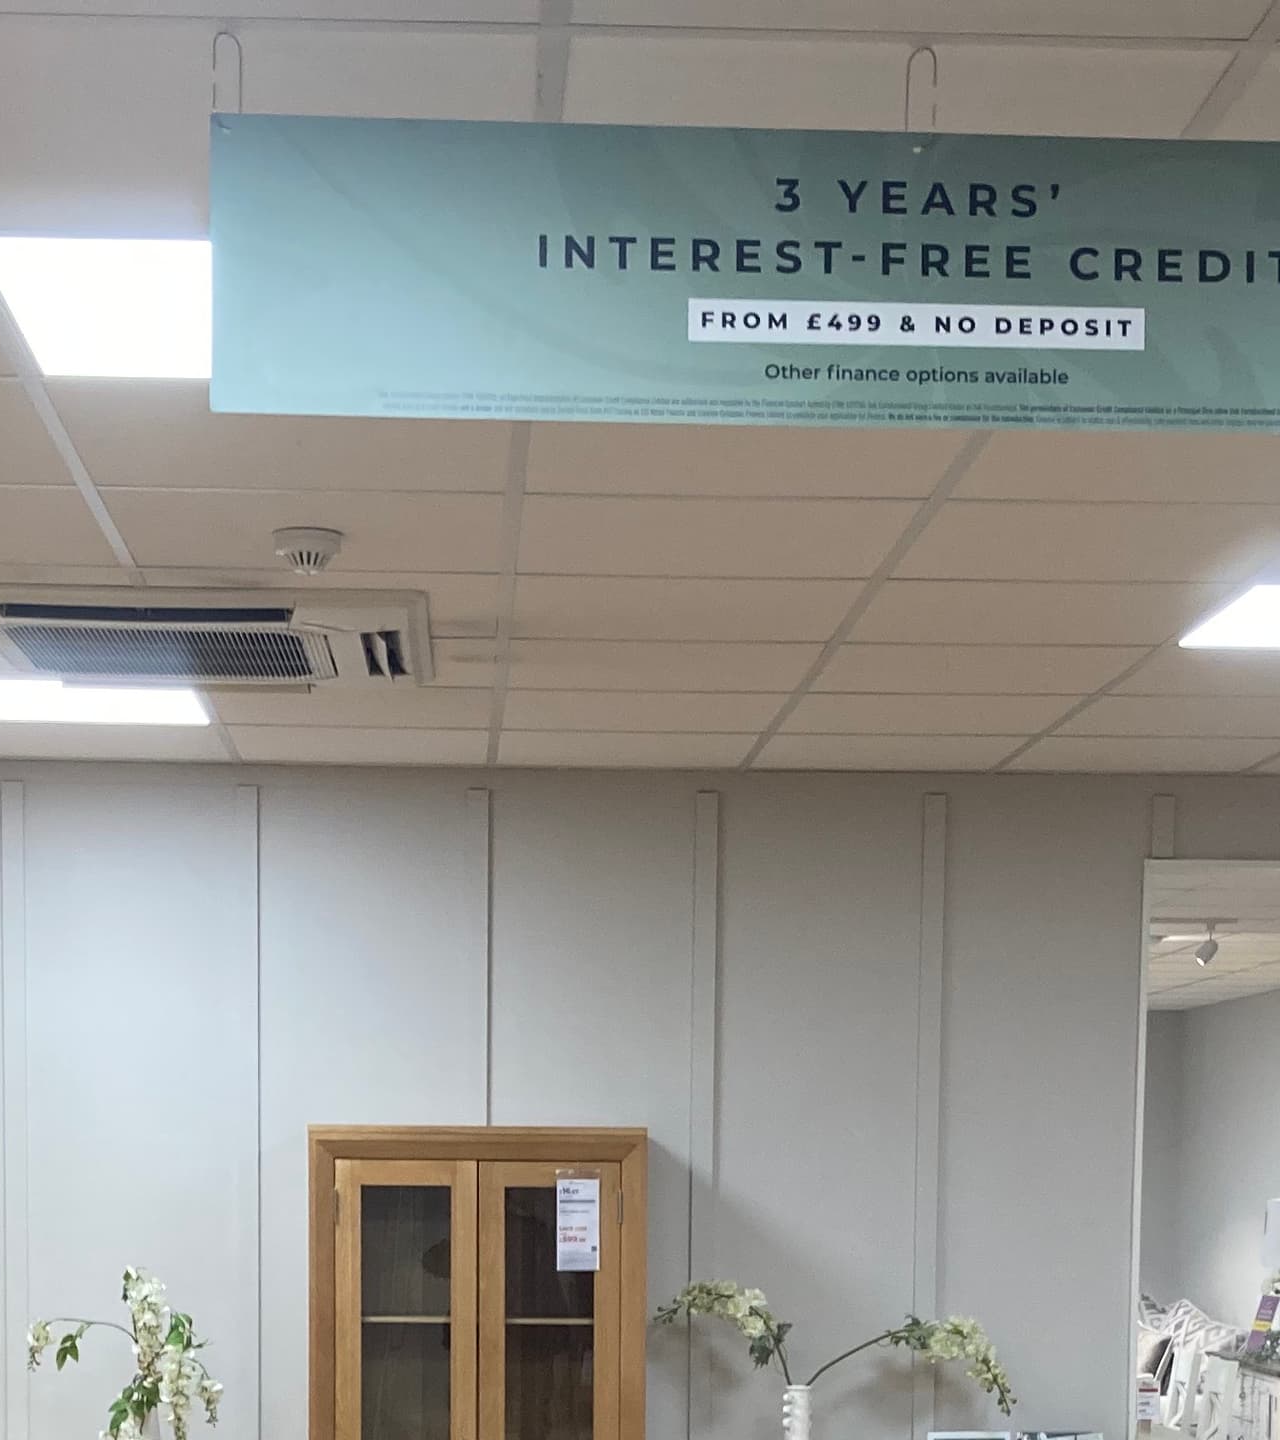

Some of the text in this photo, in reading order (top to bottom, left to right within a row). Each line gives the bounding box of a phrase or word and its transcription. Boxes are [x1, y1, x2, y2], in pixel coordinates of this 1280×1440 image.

[775, 177, 1061, 218] 3 YEARS'
[538, 233, 1032, 279] INTEREST-FREE
[701, 311, 1133, 337] FROM £499 & NO DEPOSIT
[764, 363, 1069, 386] Other finance options available
